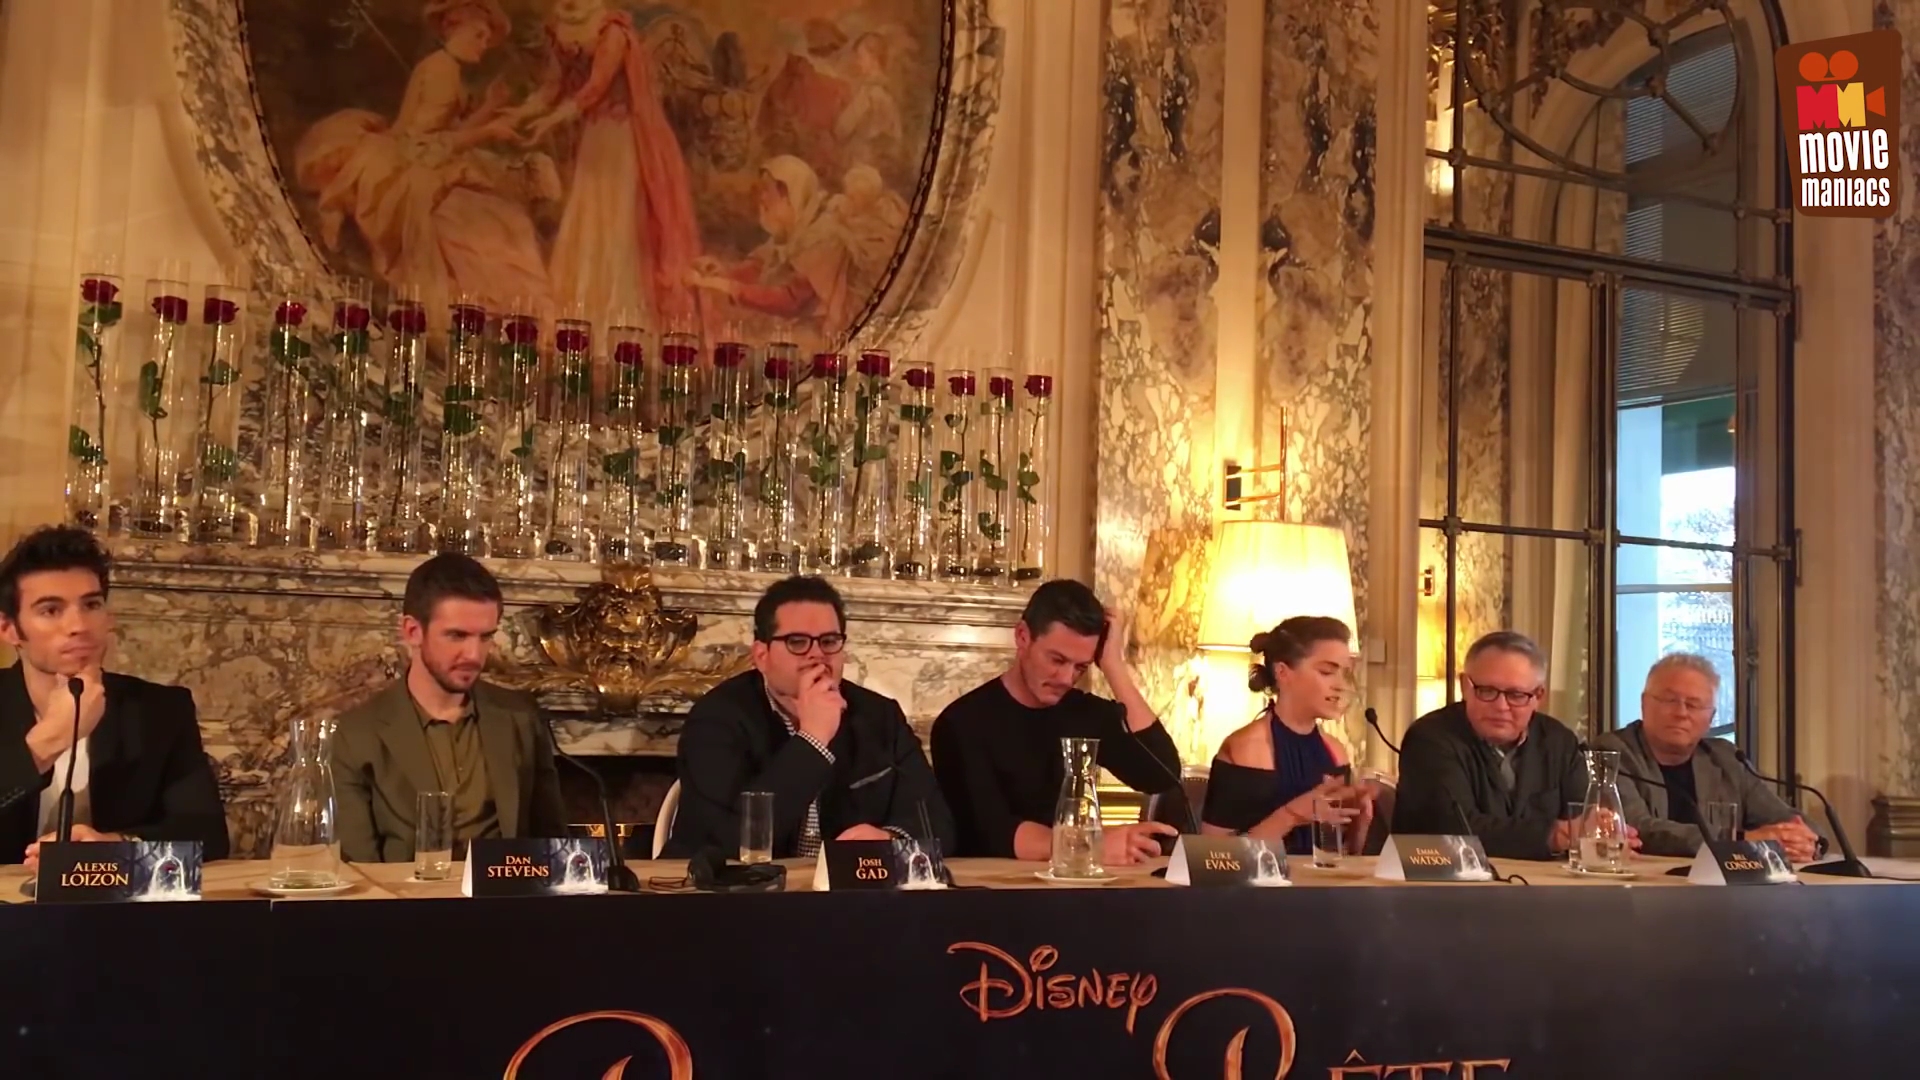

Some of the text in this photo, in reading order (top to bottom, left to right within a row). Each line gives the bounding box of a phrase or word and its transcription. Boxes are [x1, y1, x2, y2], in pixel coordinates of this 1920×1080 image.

[1209, 850, 1231, 860] LUKE
[1415, 847, 1440, 856] EMMA
[505, 855, 531, 865] DAN
[858, 857, 882, 868] JOSH
[1205, 859, 1241, 871] EVANS
[1409, 855, 1452, 866] WATSON
[1724, 860, 1764, 871] CONDON
[72, 861, 118, 872] ALEXIS
[487, 865, 550, 878] STEVENS
[856, 868, 888, 880] GAD
[61, 873, 129, 887] LOIZON
